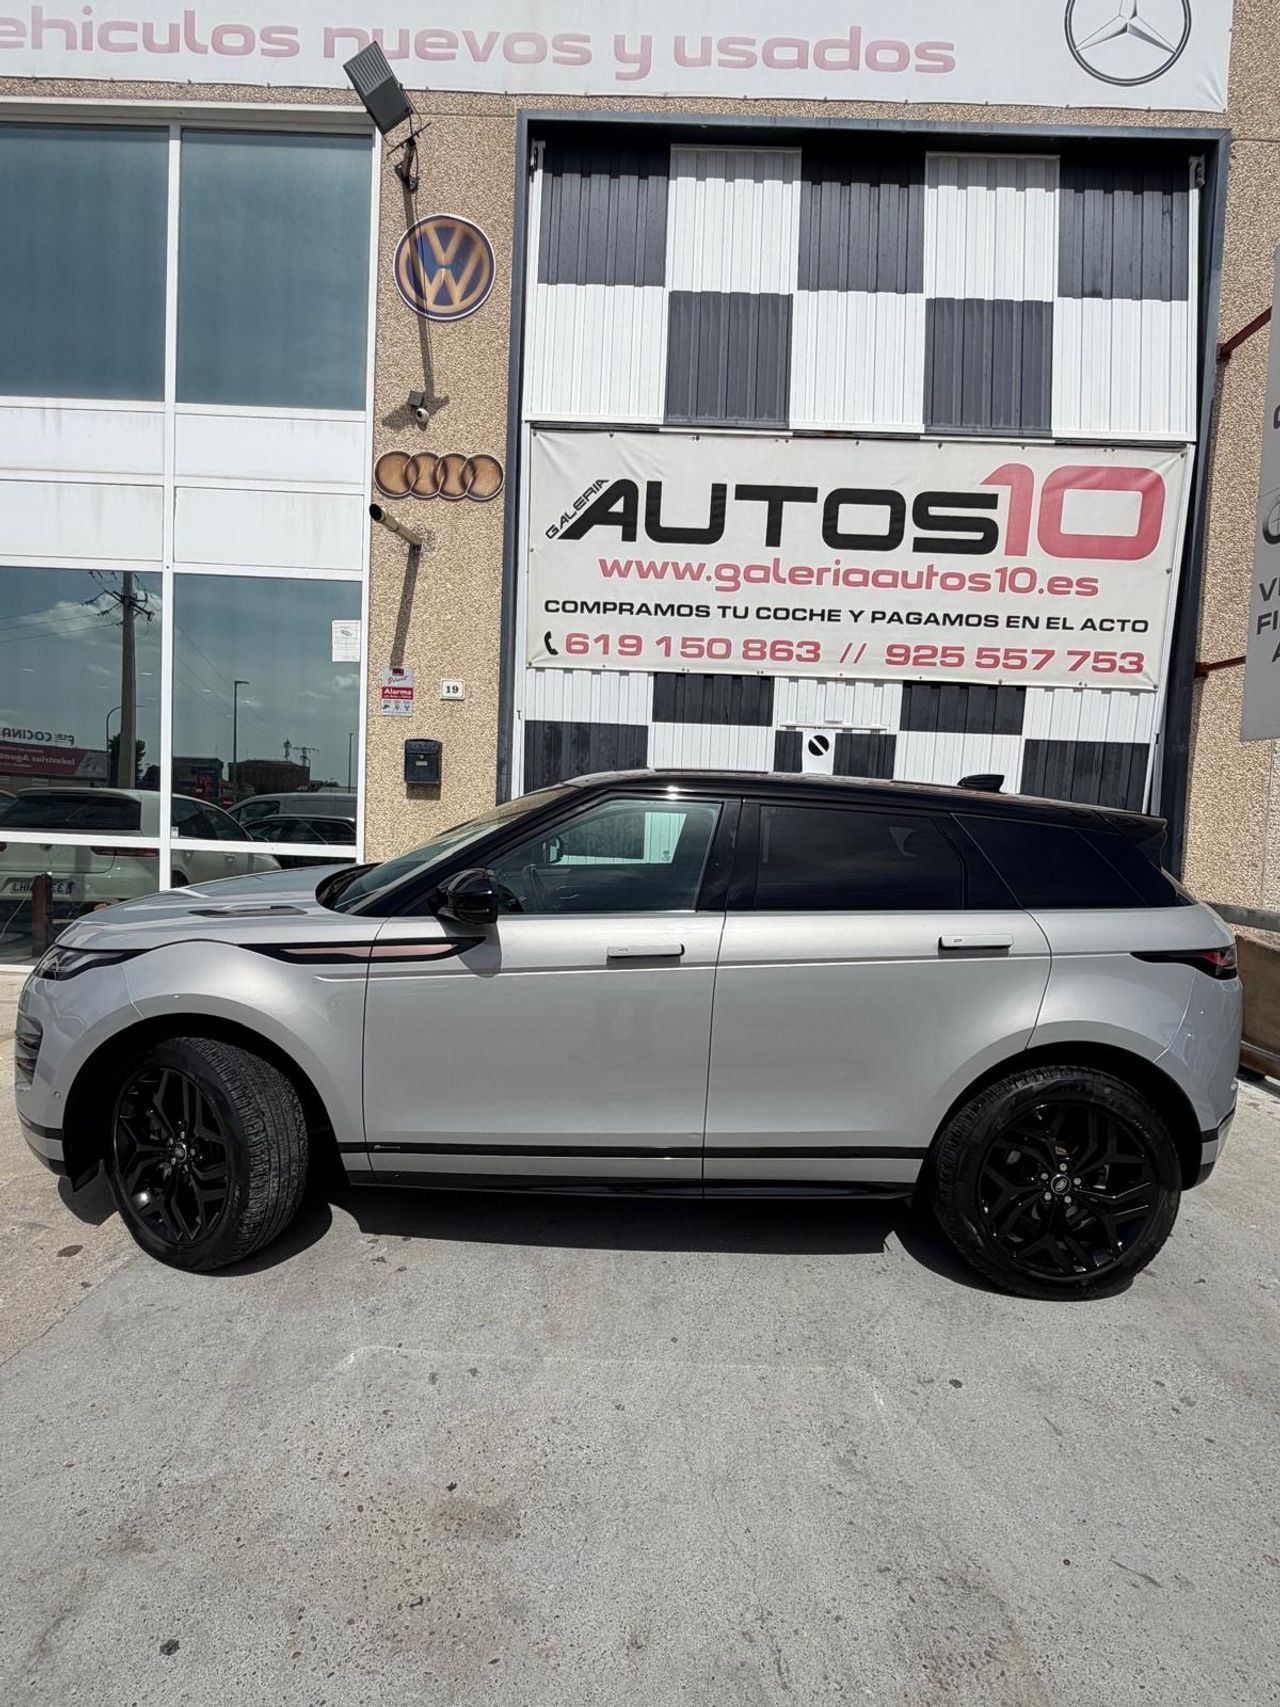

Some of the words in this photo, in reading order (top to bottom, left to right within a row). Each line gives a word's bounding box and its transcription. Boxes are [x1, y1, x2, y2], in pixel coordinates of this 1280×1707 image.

[323, 27, 592, 65] nuevos
[614, 35, 652, 81] y
[673, 26, 956, 73] usados
[545, 479, 609, 540] GALERIA
[598, 557, 1100, 597] www.galeriaautos10.es
[1259, 577, 1280, 602] V
[544, 600, 711, 619] COMPRAMOS
[717, 605, 749, 620] TU
[755, 606, 842, 623] COCHE
[848, 610, 865, 624] Y
[870, 610, 1000, 628] PAGAMOS
[1005, 615, 1039, 630] EN
[1046, 617, 1075, 631] EL
[1080, 618, 1149, 633] ACTO
[565, 632, 643, 656] 619
[655, 635, 732, 660] 150
[742, 639, 821, 663] 863
[885, 643, 966, 667] 925
[975, 647, 1055, 671] 557
[1066, 650, 1145, 674] 753
[383, 688, 412, 696] Alarma
[446, 685, 459, 694] 19
